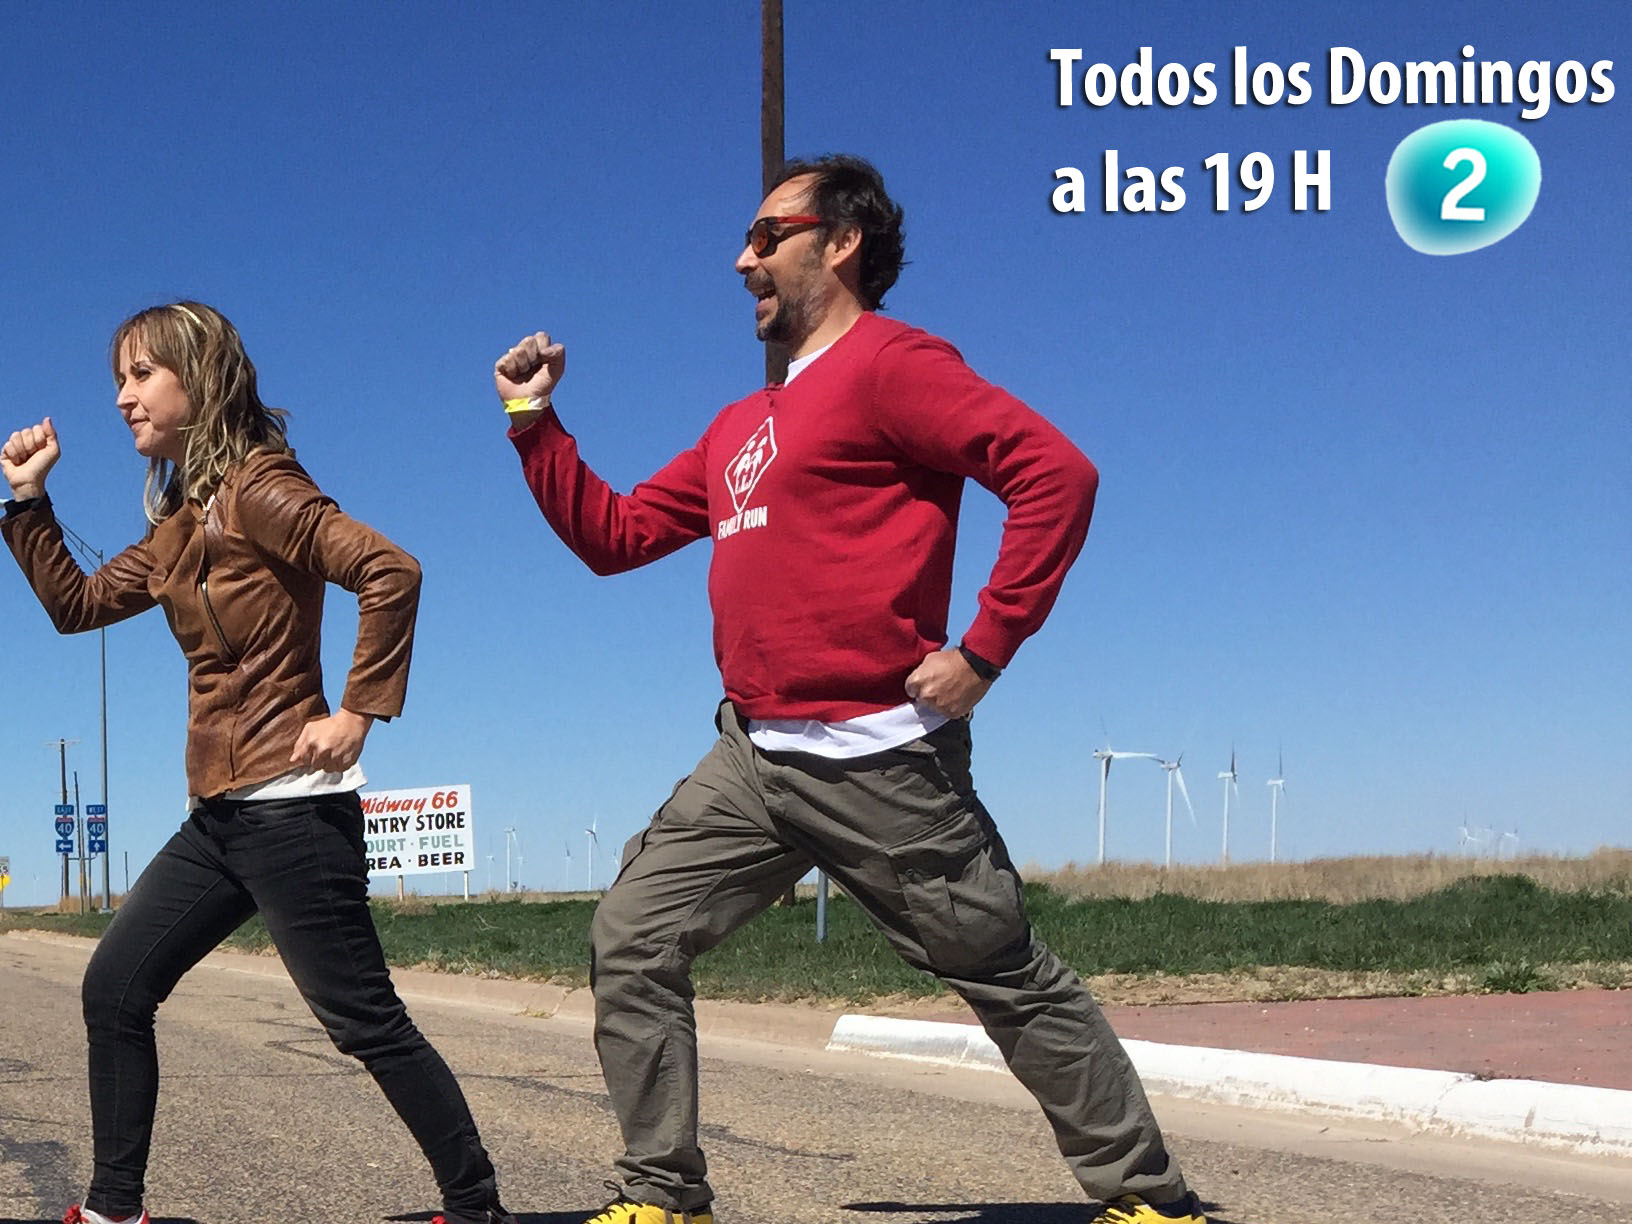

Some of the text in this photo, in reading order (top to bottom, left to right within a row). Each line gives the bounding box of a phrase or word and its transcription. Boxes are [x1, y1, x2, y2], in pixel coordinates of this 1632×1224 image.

[743, 505, 768, 530] RUN
[360, 791, 458, 814] Midway 66
[58, 823, 72, 834] 40
[90, 823, 104, 834] 40
[367, 811, 465, 835] NTRY STORE
[366, 834, 464, 853] OURT FUEL
[367, 852, 465, 870] REA BEER
